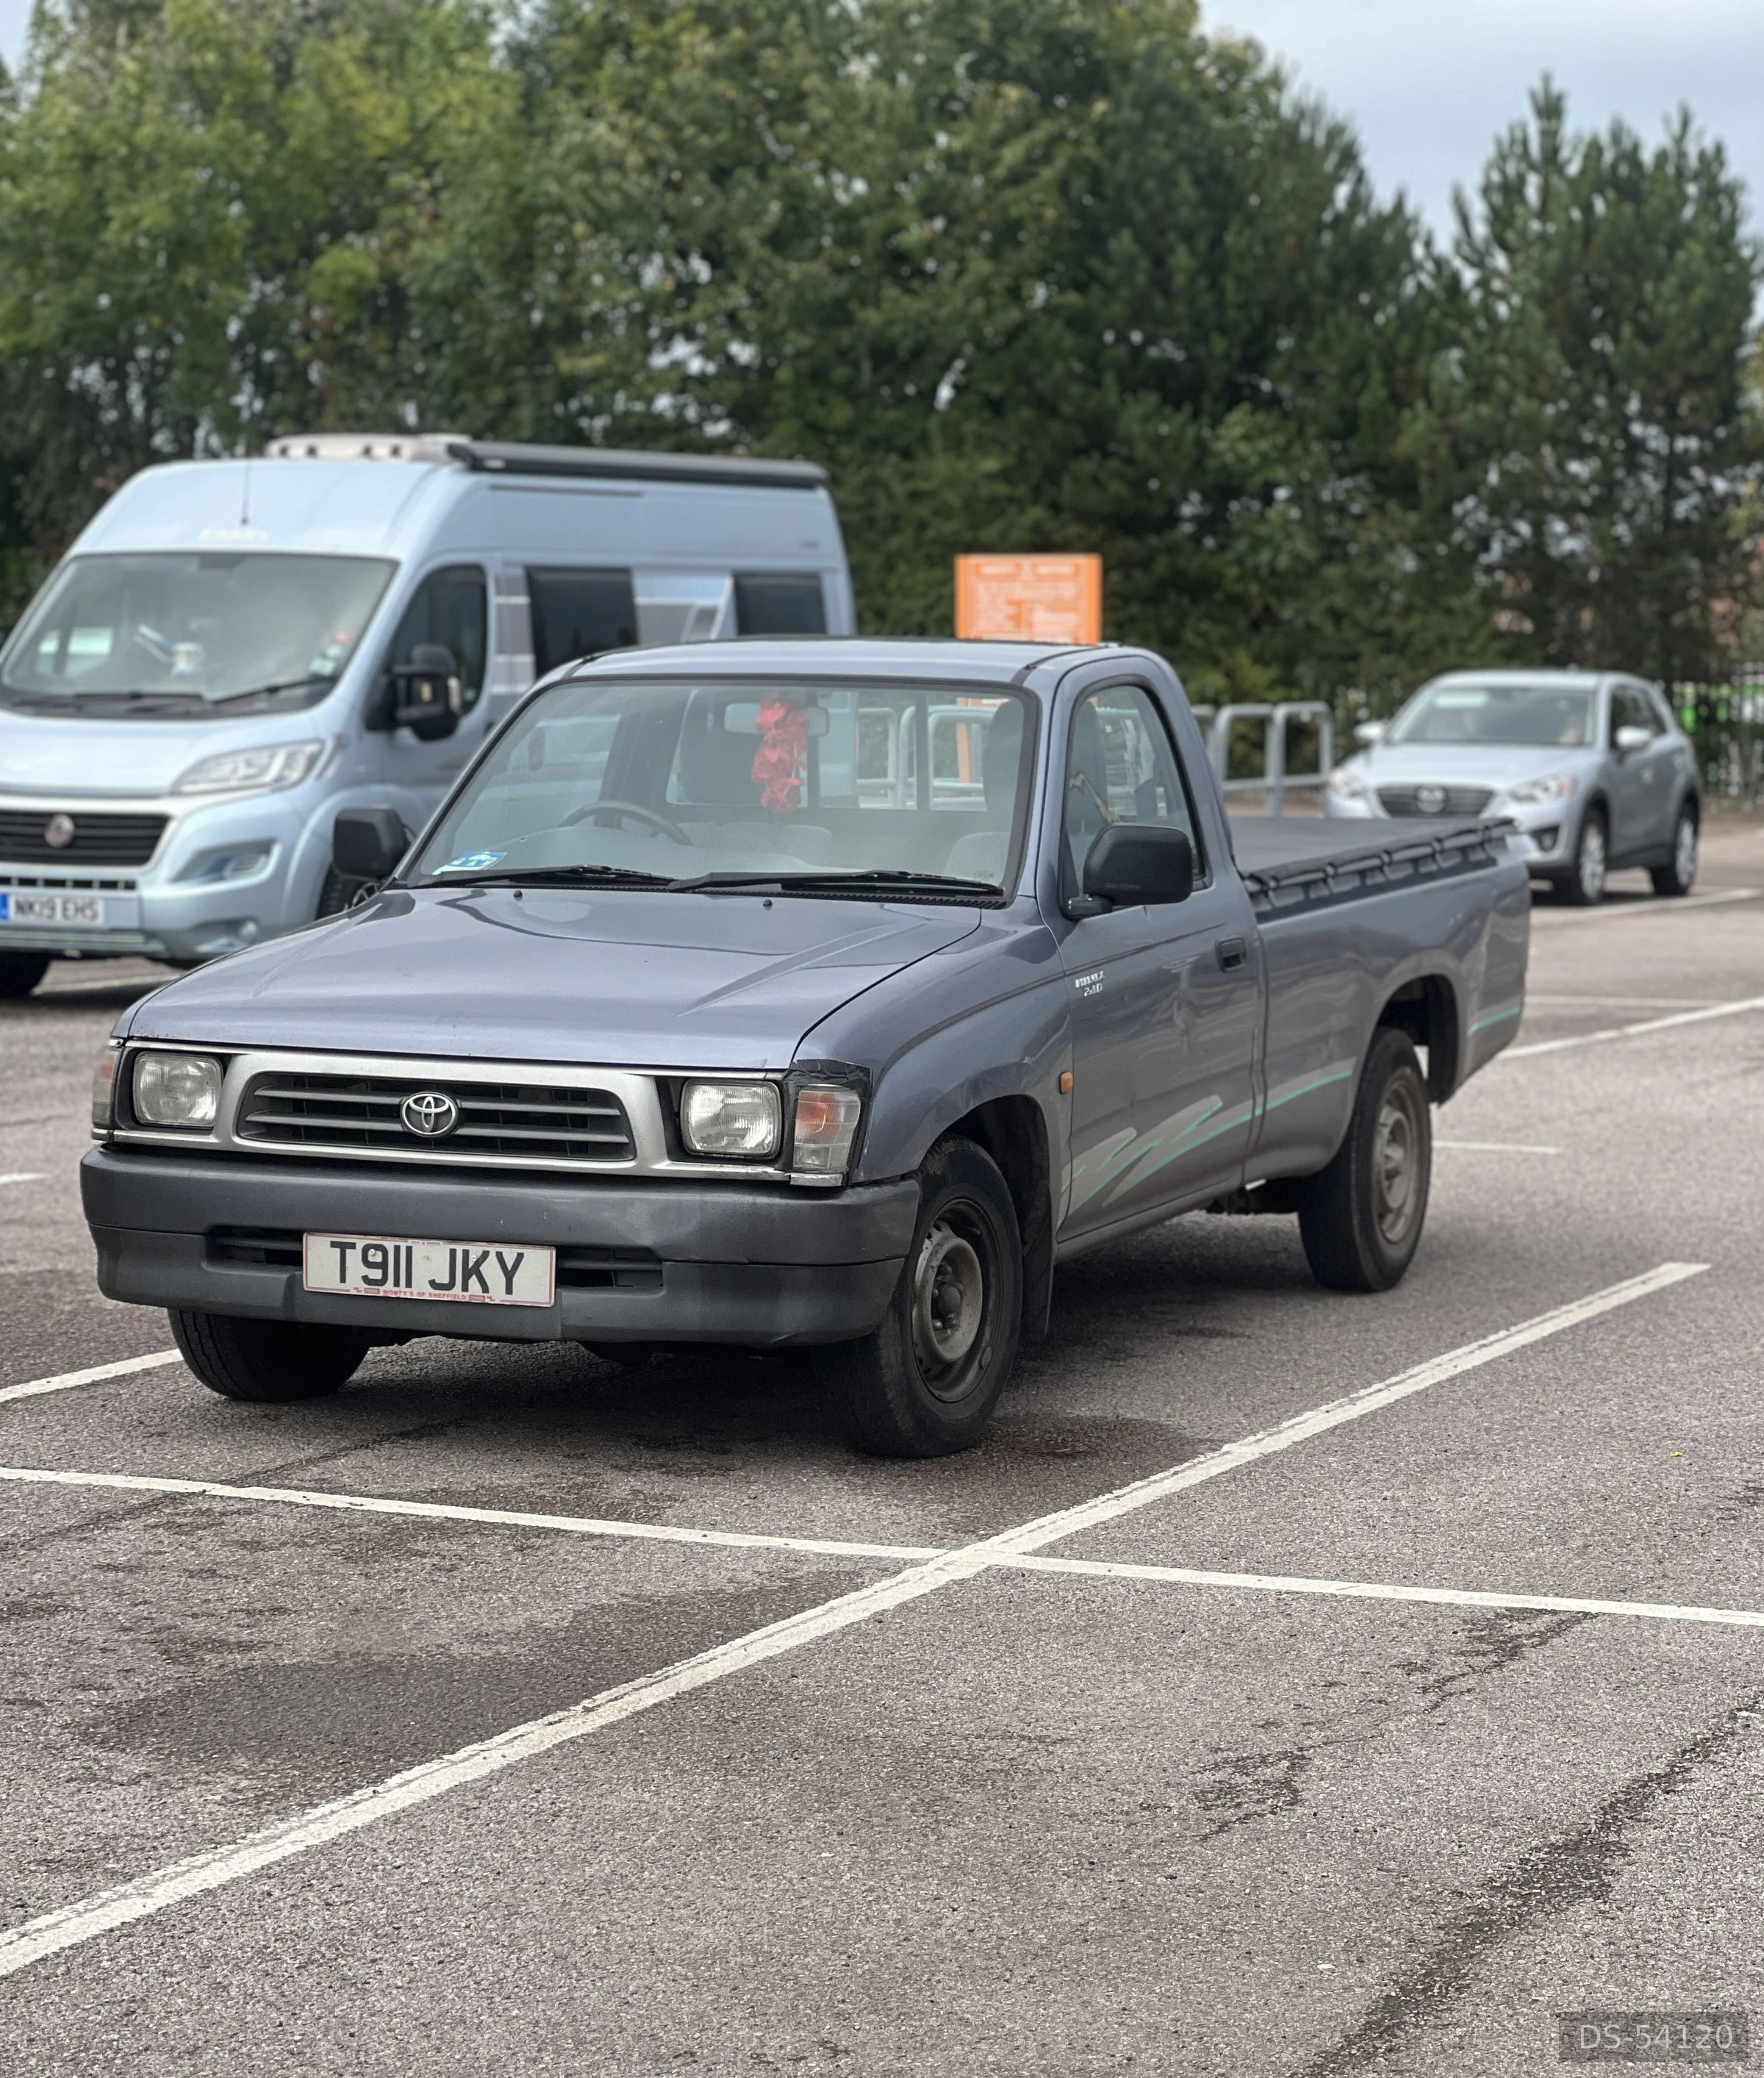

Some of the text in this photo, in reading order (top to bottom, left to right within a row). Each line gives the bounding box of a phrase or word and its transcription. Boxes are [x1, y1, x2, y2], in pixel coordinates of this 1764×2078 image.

[1075, 970, 1105, 988] HILUX
[330, 1241, 525, 1295] T911 JKY
[429, 1292, 466, 1300] SHEFFIELD
